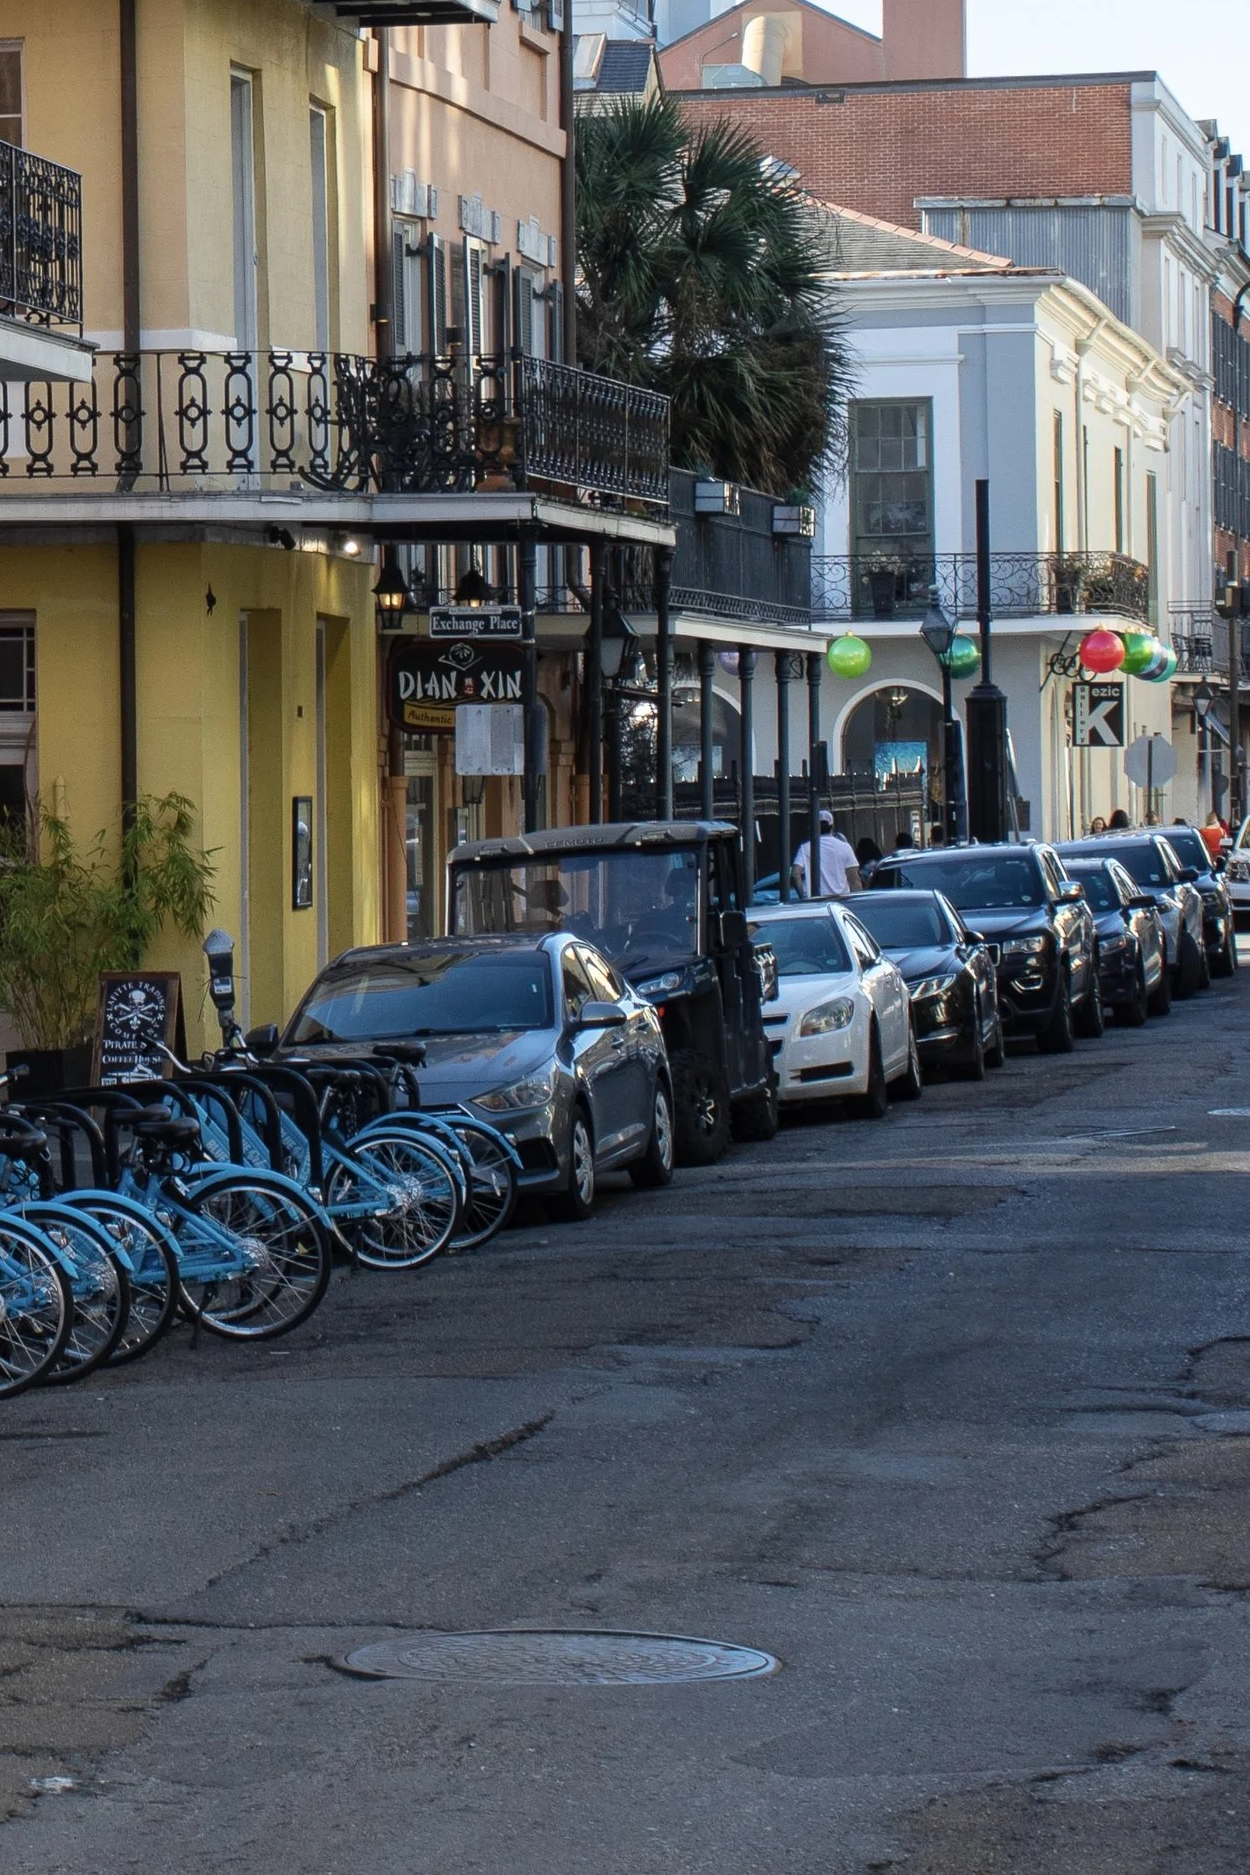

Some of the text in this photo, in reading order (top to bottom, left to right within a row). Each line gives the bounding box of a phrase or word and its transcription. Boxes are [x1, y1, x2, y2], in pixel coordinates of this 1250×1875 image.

[432, 615, 518, 635] Exchange Place
[398, 670, 457, 700] DIAN
[480, 670, 522, 699] XIN
[407, 709, 452, 724] Authentic
